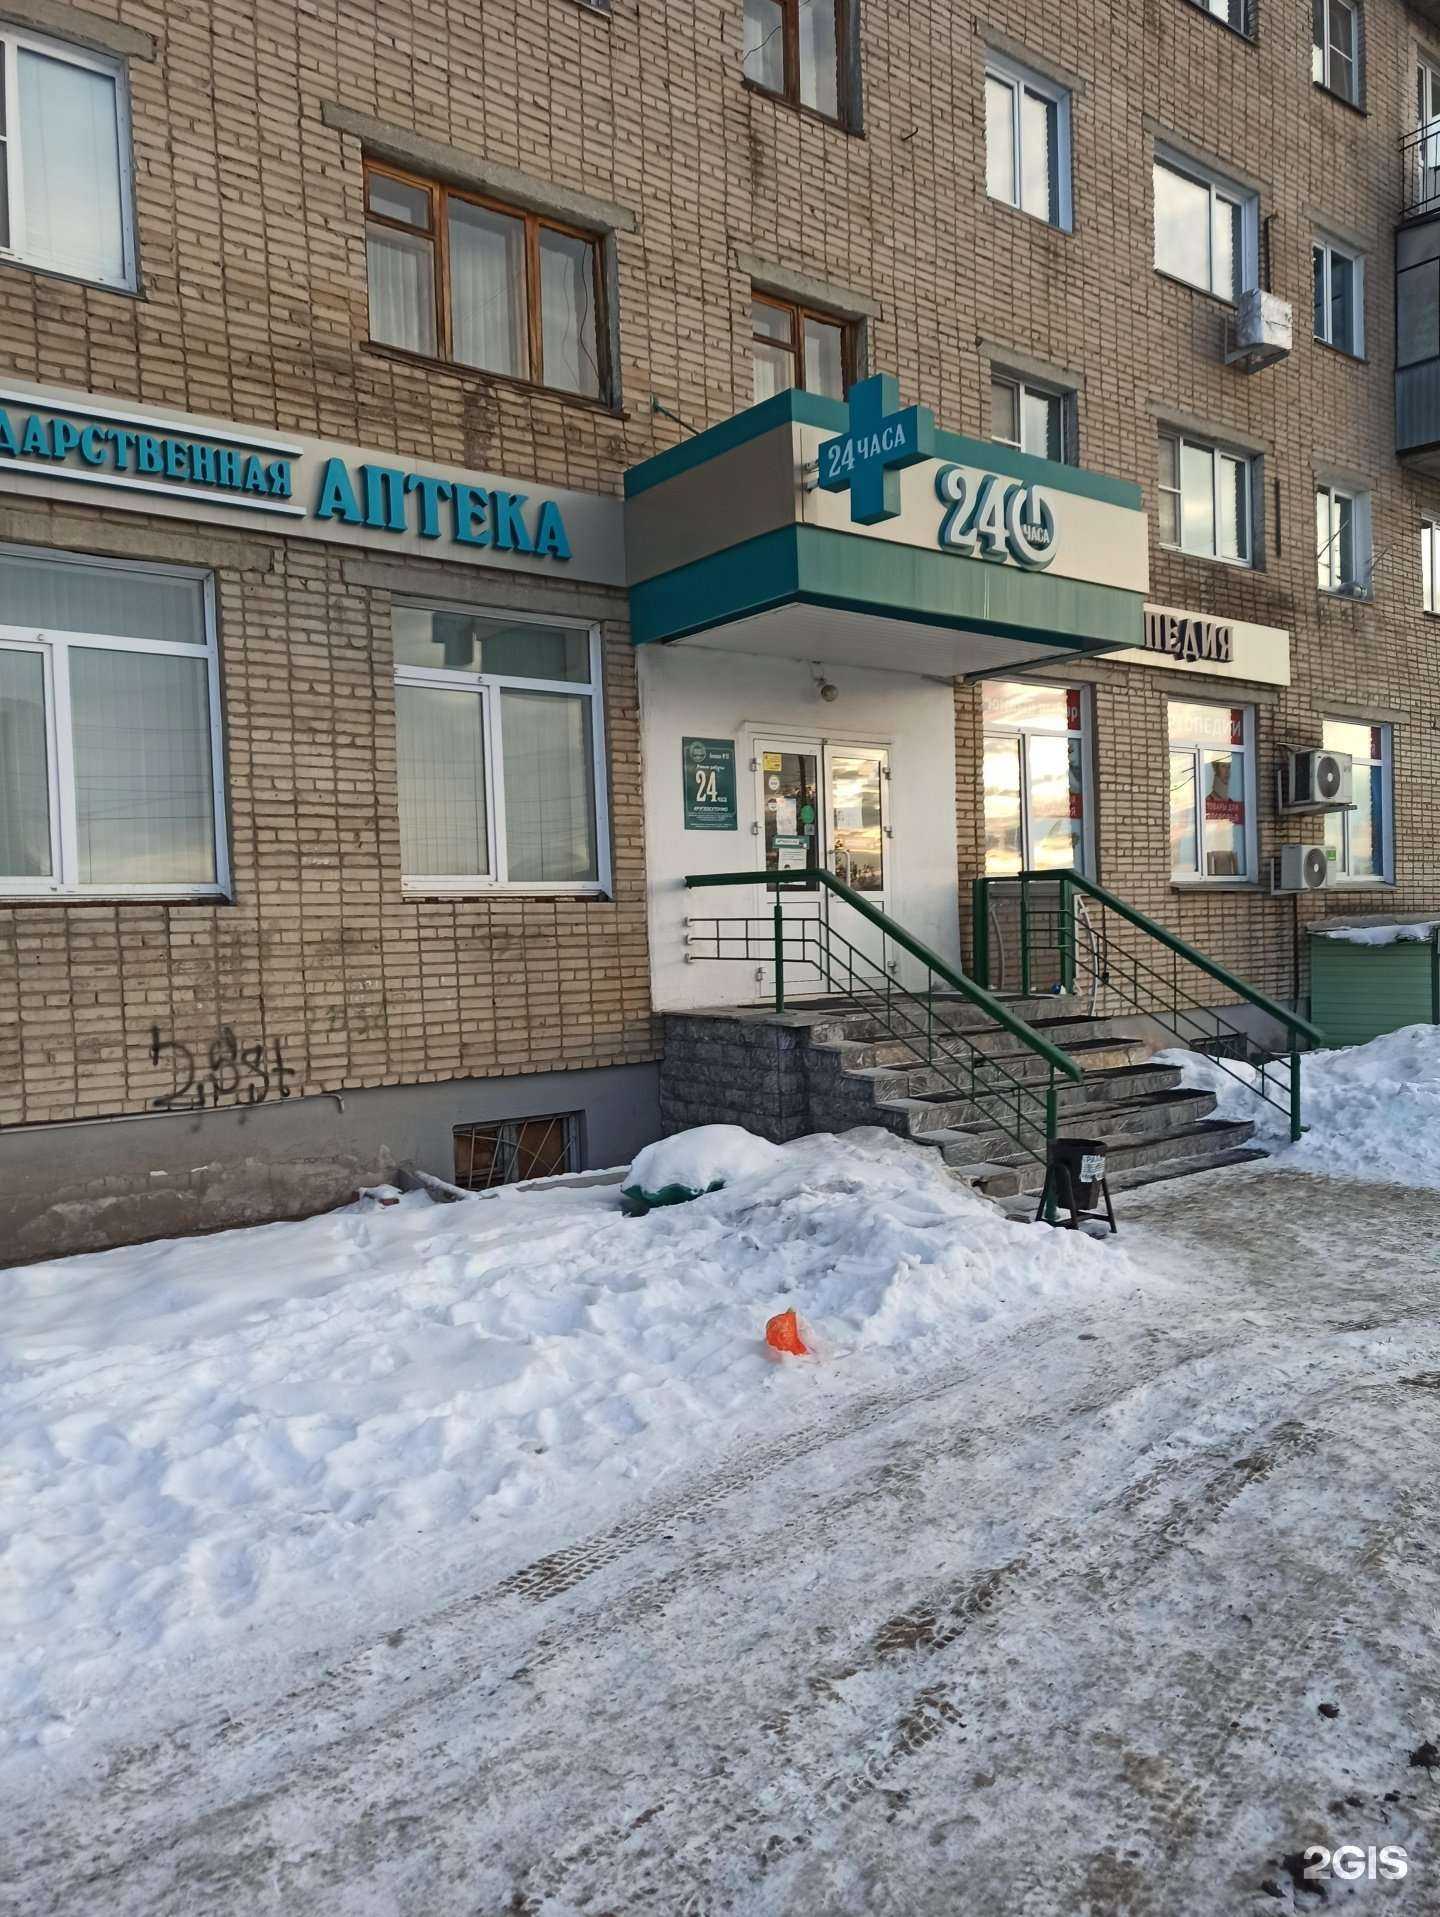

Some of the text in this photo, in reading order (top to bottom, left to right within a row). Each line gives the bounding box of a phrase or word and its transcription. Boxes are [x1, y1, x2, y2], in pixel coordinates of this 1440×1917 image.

[828, 423, 906, 478] 24 ЧАСА
[314, 457, 573, 560] АПТЕКА
[1022, 526, 1051, 544] ЧАСА
[1144, 611, 1234, 663] ПЕДИЯ
[695, 770, 717, 802] 24
